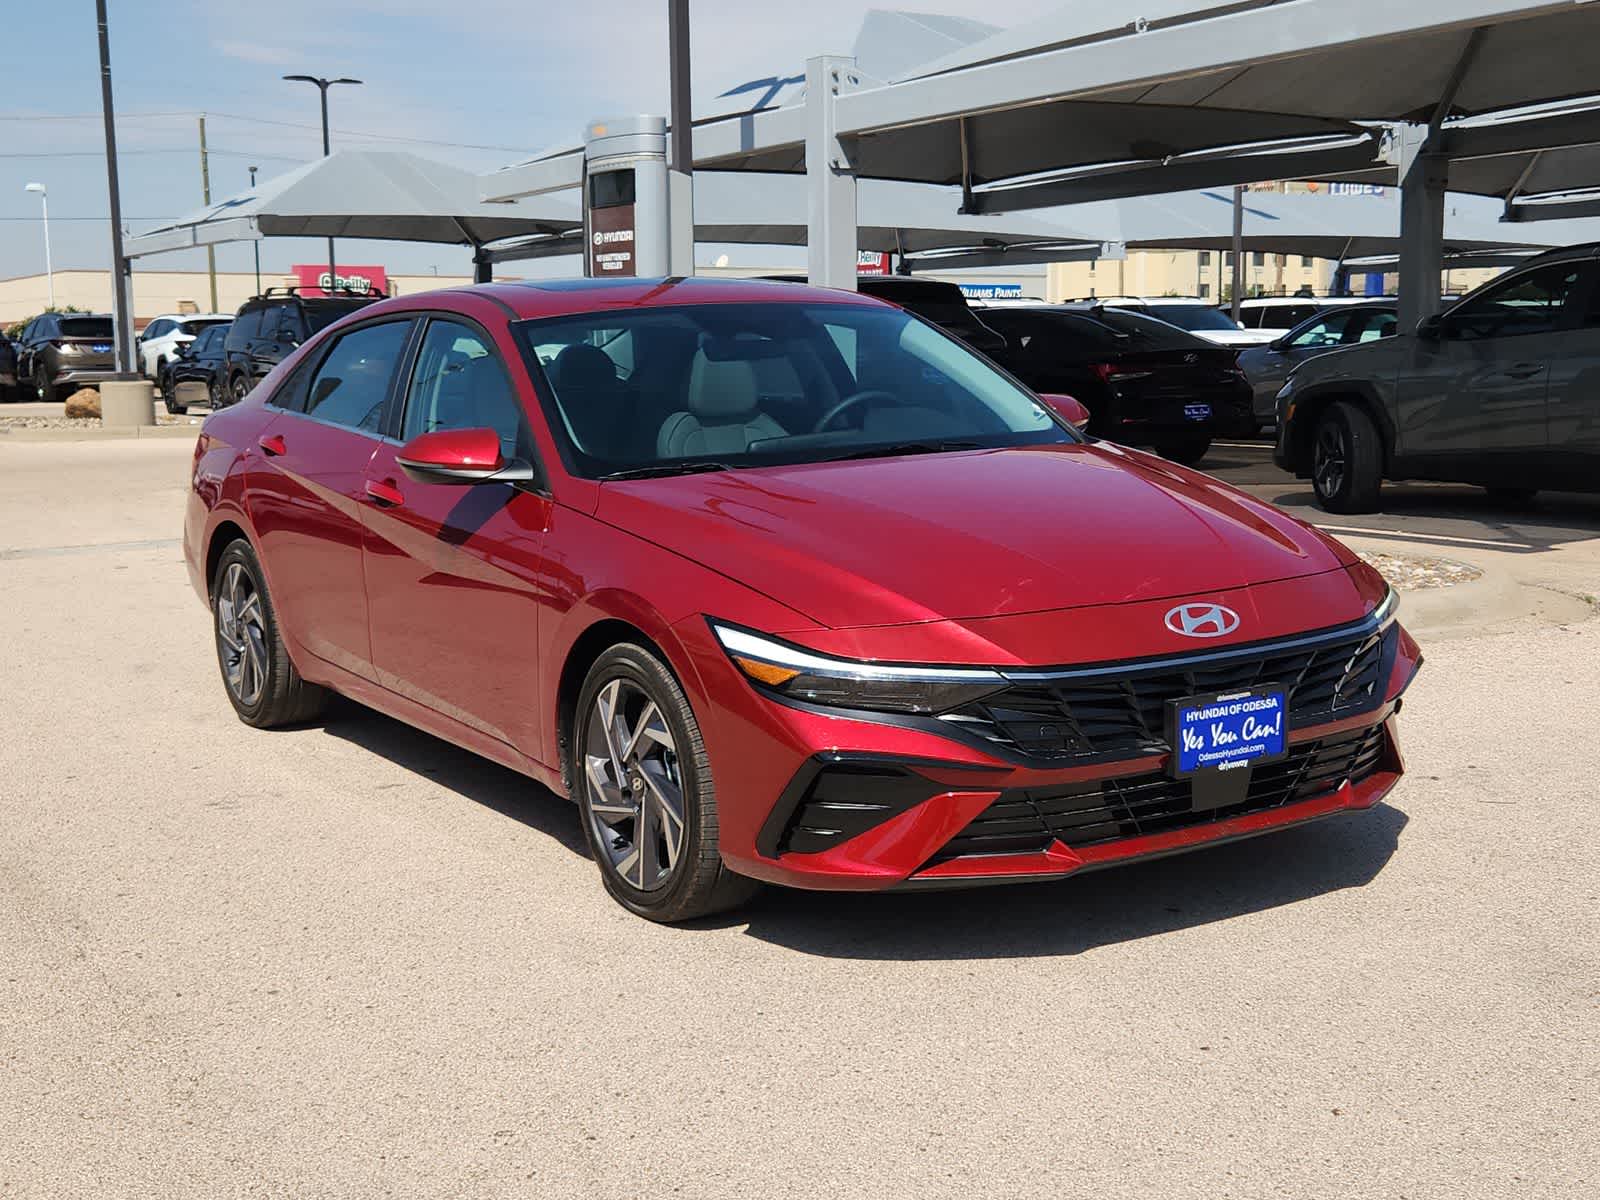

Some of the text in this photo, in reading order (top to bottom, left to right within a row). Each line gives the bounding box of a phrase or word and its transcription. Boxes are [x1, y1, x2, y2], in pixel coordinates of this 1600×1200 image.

[320, 273, 370, 294] OReilly
[1186, 698, 1278, 722] HYUNDAI OF ODESSA
[1182, 711, 1281, 752] Yes You Can!
